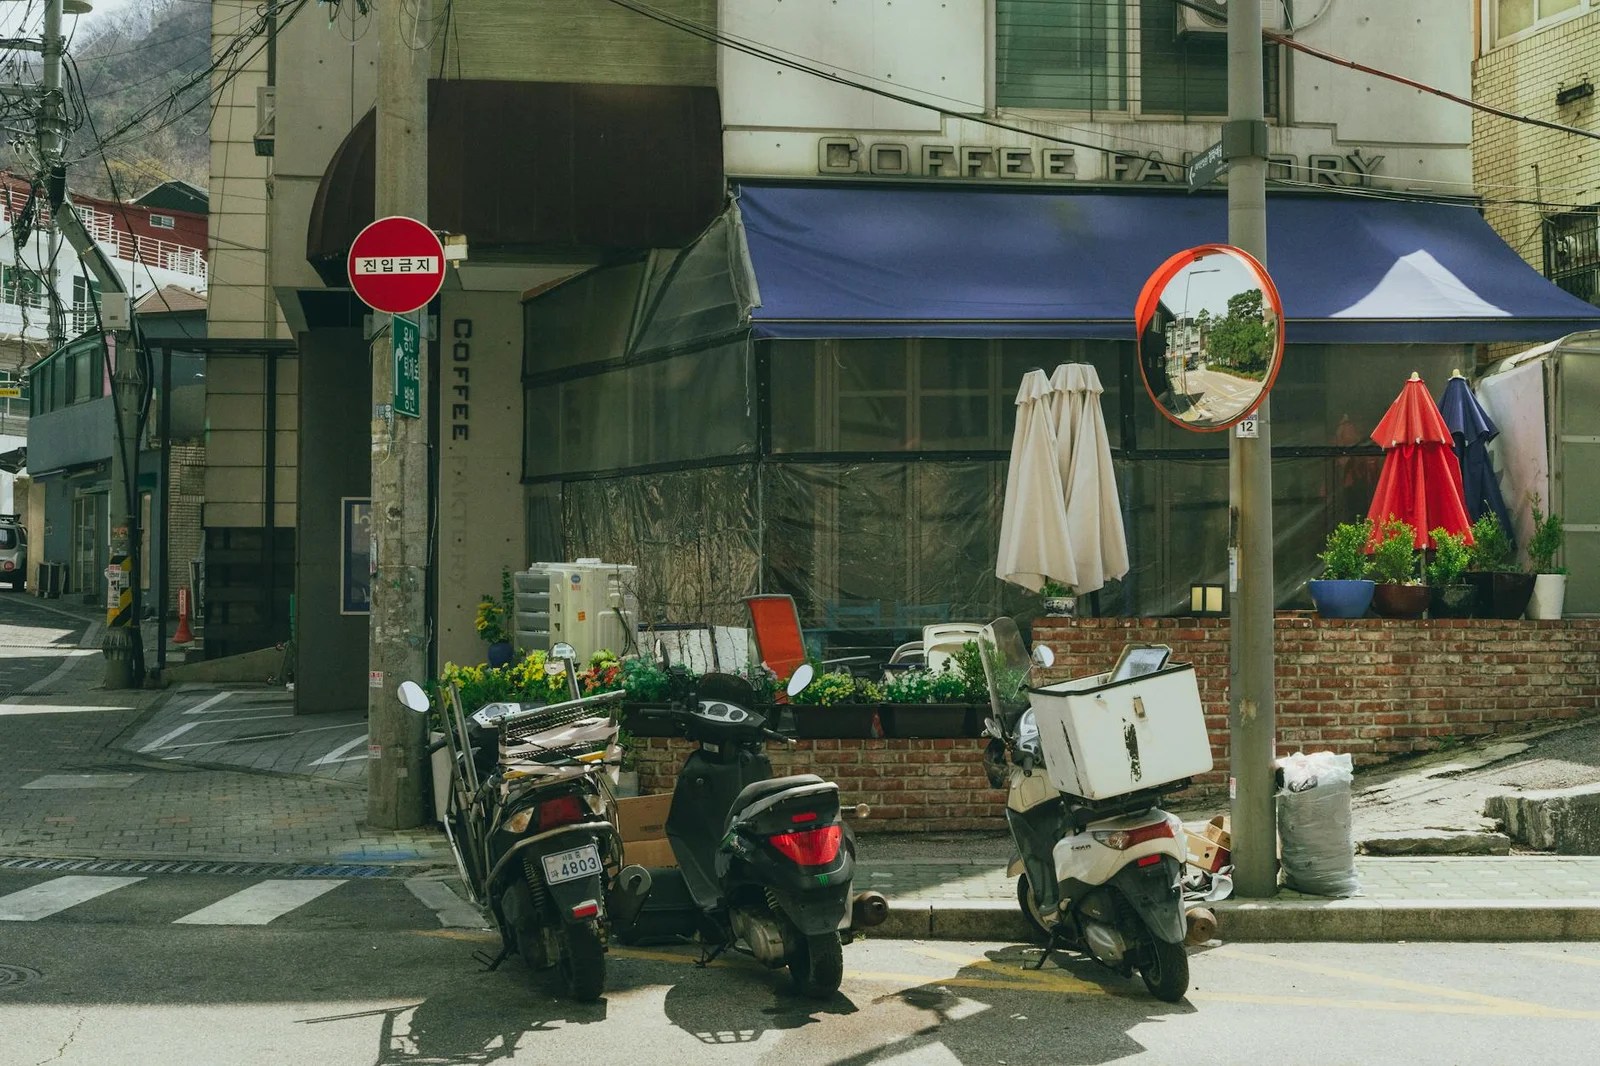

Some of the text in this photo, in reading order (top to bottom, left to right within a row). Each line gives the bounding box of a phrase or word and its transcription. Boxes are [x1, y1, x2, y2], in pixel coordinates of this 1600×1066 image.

[818, 137, 1076, 180] COFFEE
[1102, 150, 1385, 187] FAORY
[363, 258, 430, 272] 진입금지
[452, 319, 472, 441] COFFEE
[1240, 421, 1253, 431] 12
[562, 857, 596, 876] 4803
